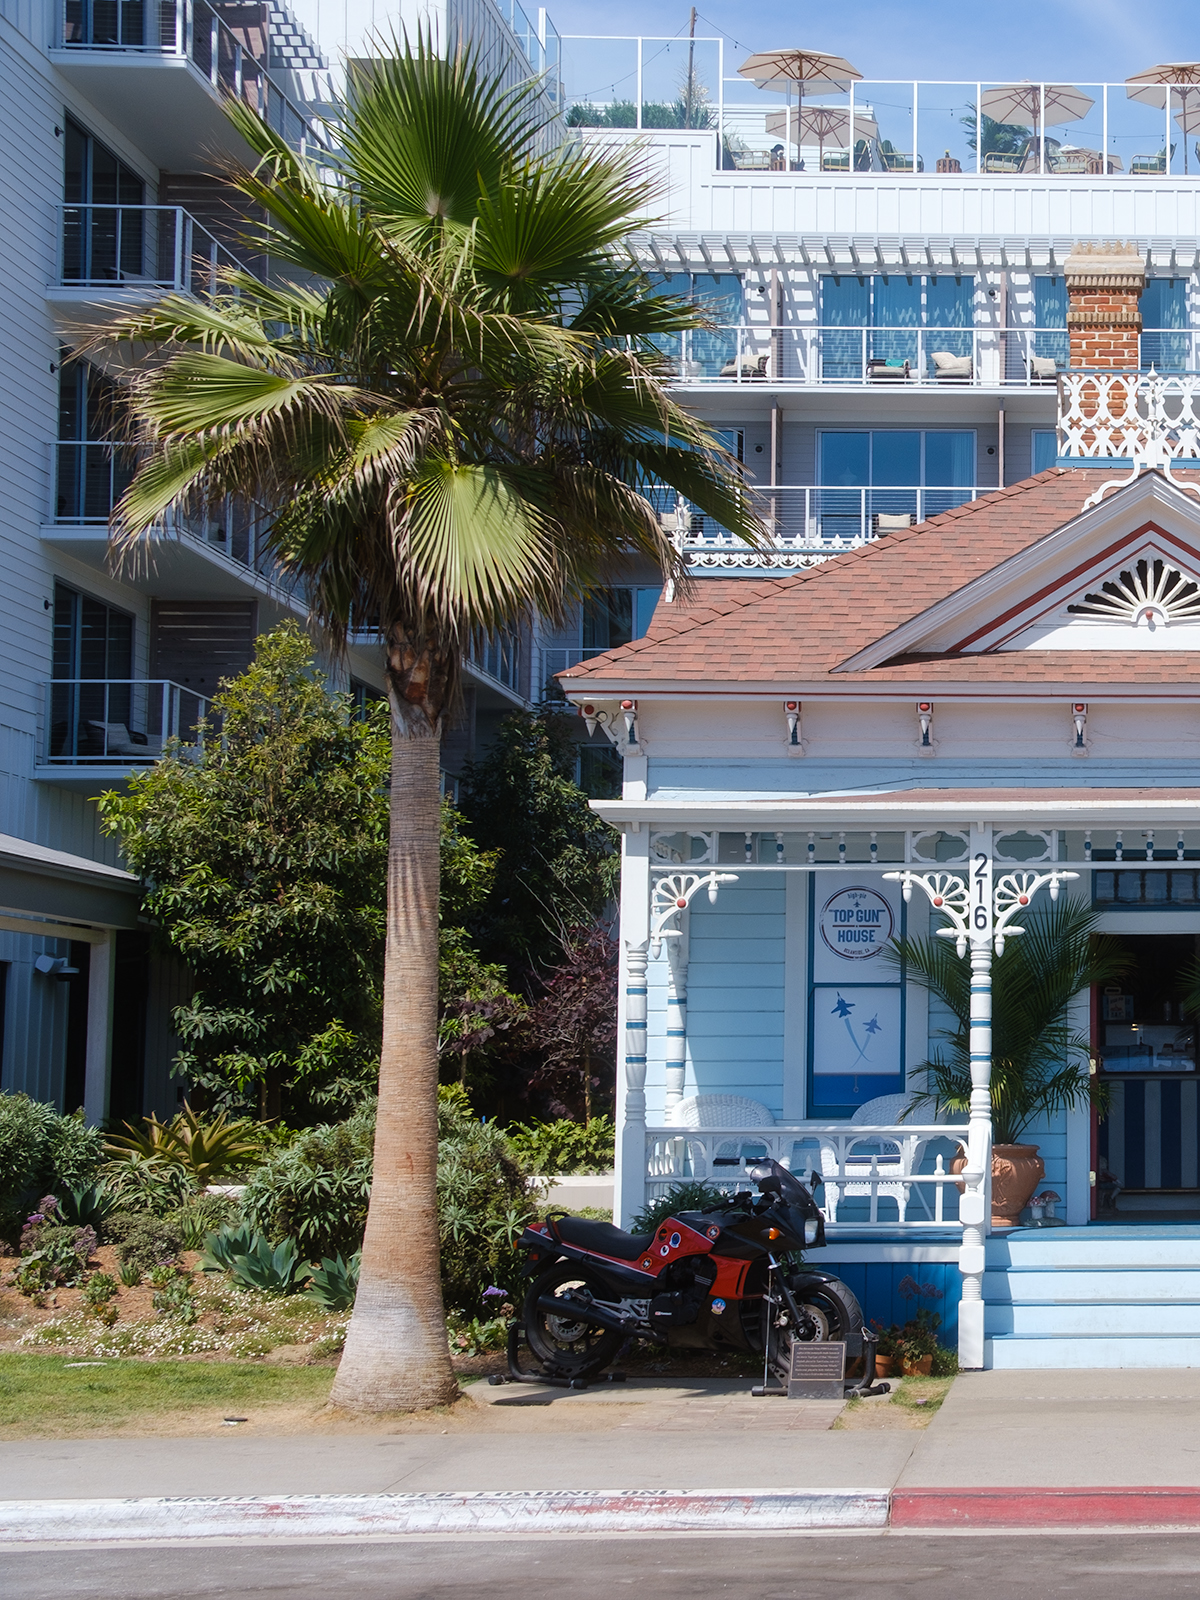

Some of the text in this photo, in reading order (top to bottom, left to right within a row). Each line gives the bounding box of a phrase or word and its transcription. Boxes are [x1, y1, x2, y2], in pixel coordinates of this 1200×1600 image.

[974, 853, 988, 930] 216
[829, 909, 885, 923] TOP GUN
[838, 929, 875, 943] HOUSE
[473, 1490, 601, 1498] LOADING
